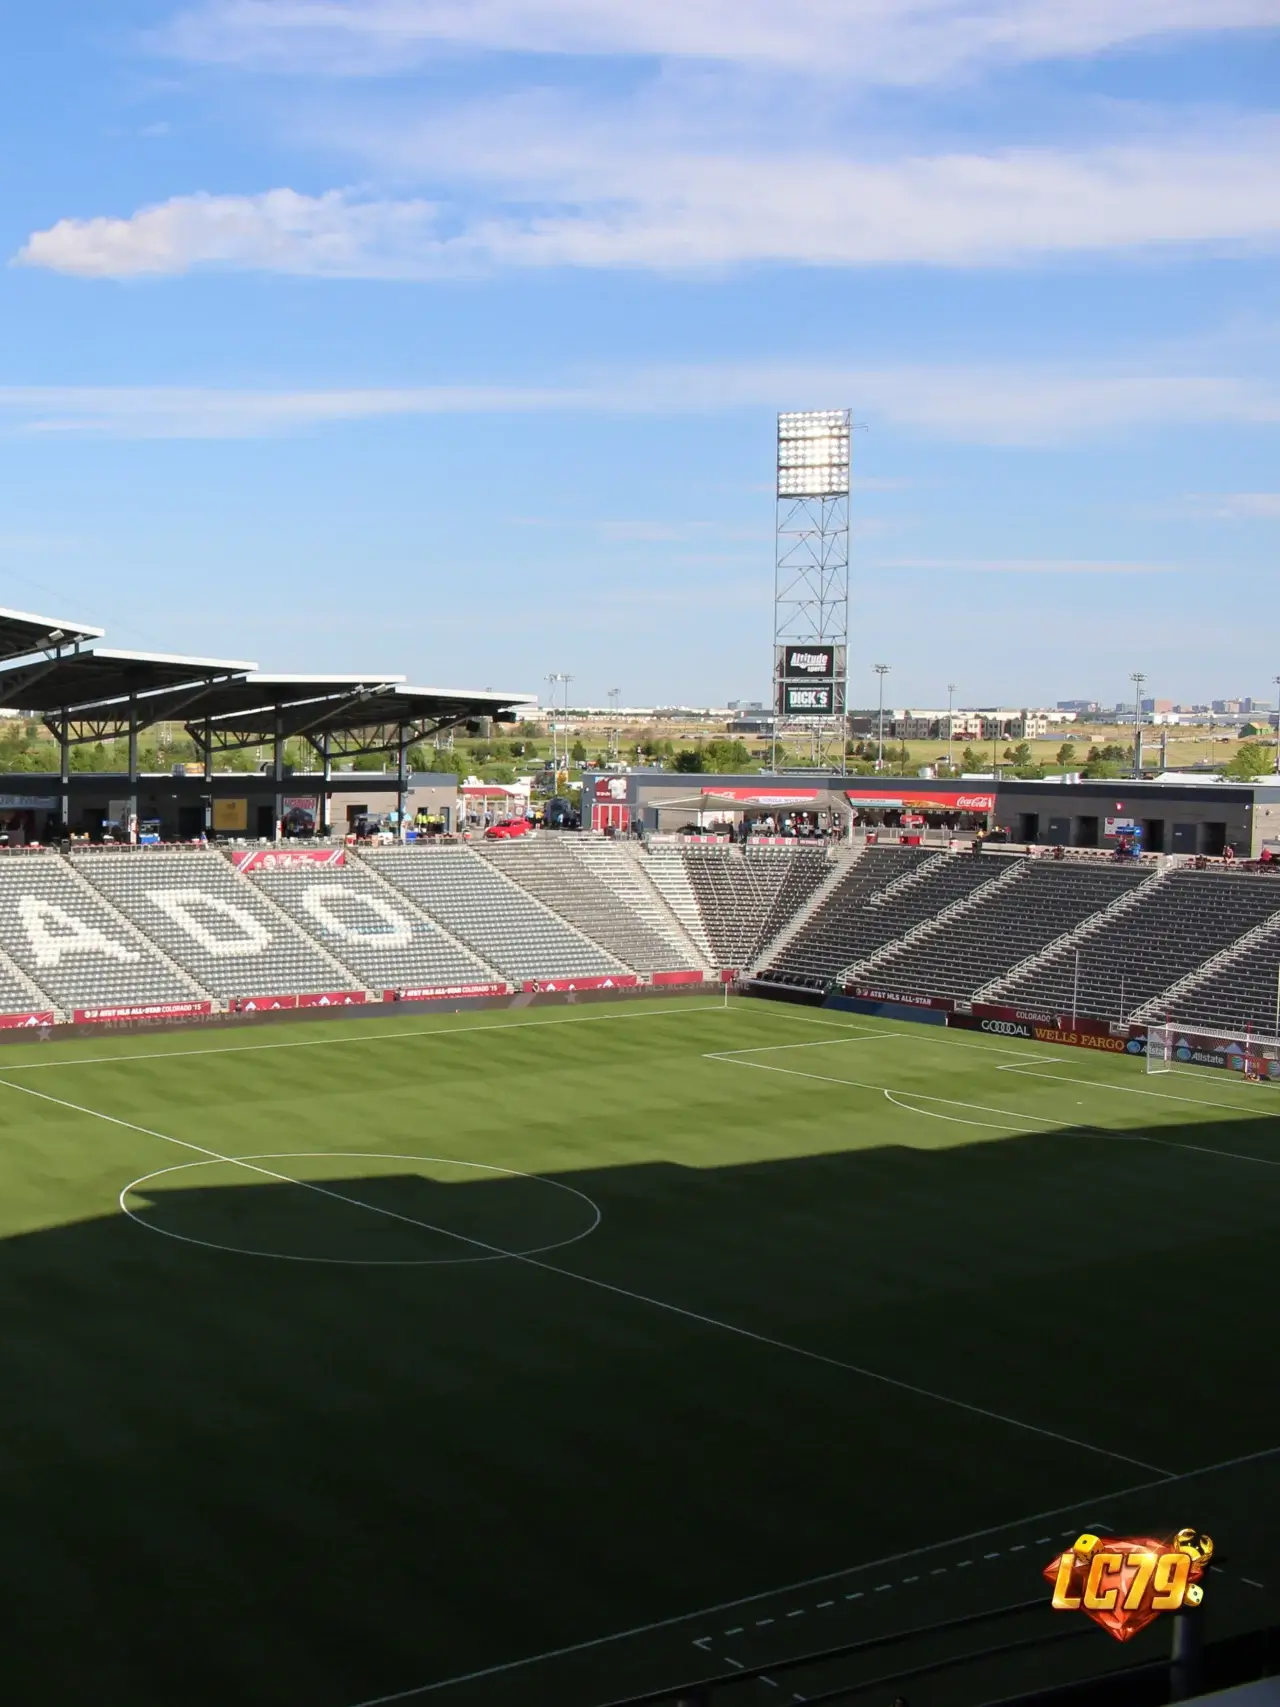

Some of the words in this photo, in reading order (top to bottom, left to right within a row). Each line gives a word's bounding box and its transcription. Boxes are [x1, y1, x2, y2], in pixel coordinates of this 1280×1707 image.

[790, 691, 828, 704] DICK'S
[956, 796, 988, 807] Coca-Cola
[870, 990, 886, 998] AT&T
[887, 993, 900, 1001] MLS
[901, 995, 932, 1005] ALL-STAR
[131, 1006, 161, 1016] ALL-STAR
[162, 1004, 192, 1013] COLORADO
[1016, 1011, 1050, 1023] COLORADO
[1035, 1027, 1077, 1044] WELLS
[1080, 1033, 1125, 1051] FARGO
[1191, 1051, 1224, 1065] Allstate
